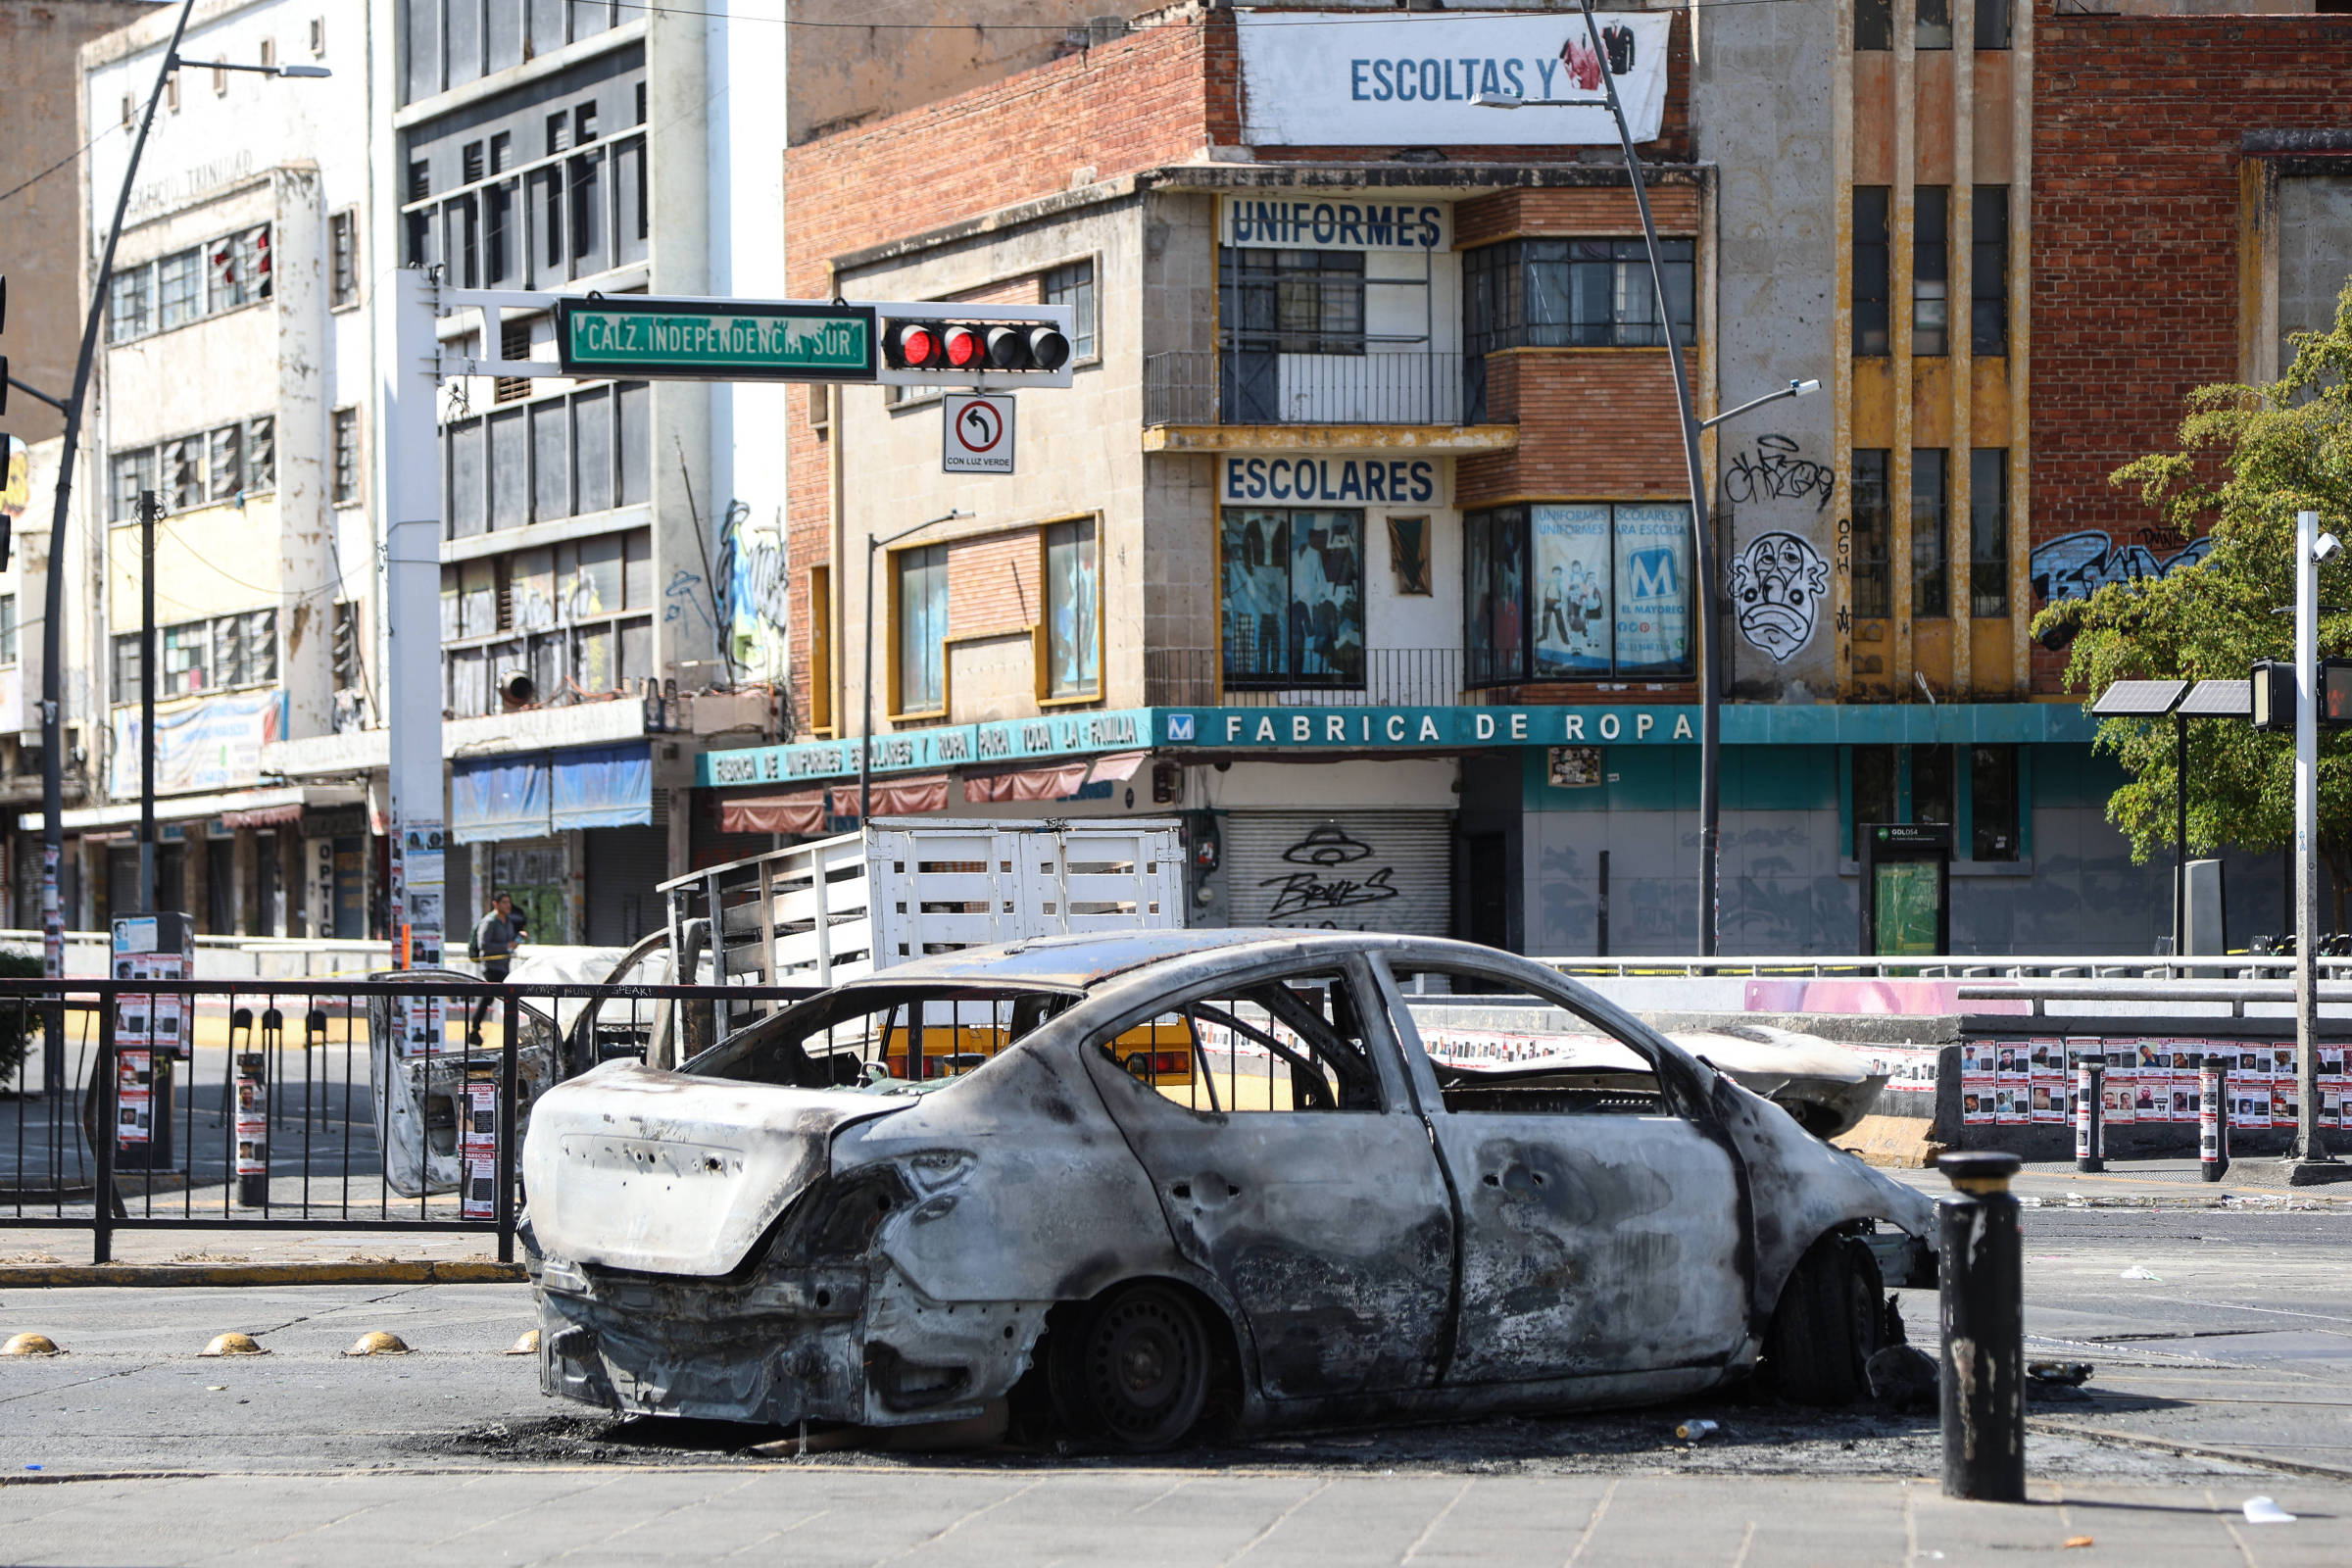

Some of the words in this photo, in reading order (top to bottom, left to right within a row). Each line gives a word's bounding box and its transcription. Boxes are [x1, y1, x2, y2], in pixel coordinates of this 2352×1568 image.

[1351, 59, 1524, 101] ESCOLTAS
[1536, 59, 1558, 99] Y
[1233, 199, 1442, 247] UNIFORMES
[589, 323, 644, 352] CALZ.
[649, 325, 803, 355] INDEPENDENCIA
[813, 329, 850, 355] SUR
[1227, 458, 1434, 502] ESCOLARES
[1539, 509, 1607, 521] UNIFORMES
[1616, 510, 1675, 521] SCOLARES
[1539, 523, 1605, 535] UNIFORMES
[1226, 715, 1440, 742] FABRICA
[1476, 713, 1529, 740] DE
[1565, 712, 1693, 740] ROPA
[850, 739, 913, 771] ESOLARES
[979, 728, 1011, 757] PARA
